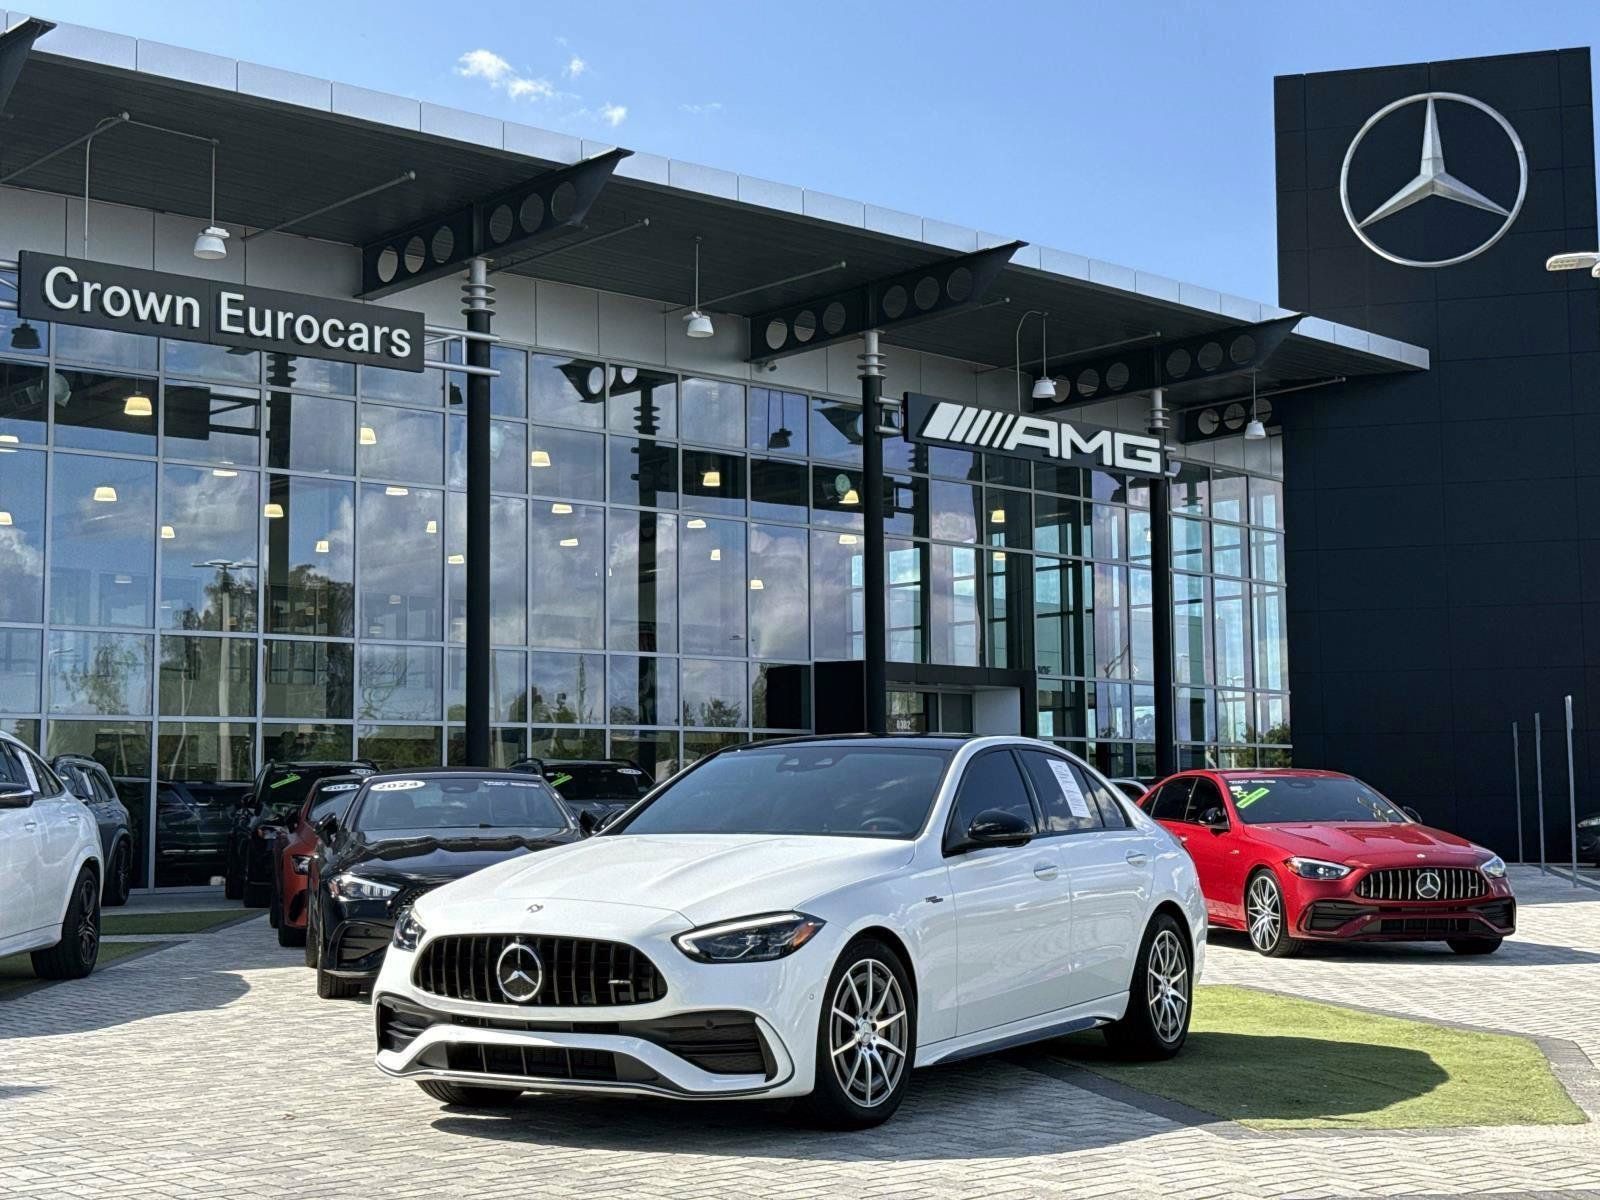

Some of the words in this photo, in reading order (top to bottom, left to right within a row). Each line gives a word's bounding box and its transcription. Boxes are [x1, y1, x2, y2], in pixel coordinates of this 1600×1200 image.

[45, 266, 200, 328] Crown
[220, 291, 412, 358] Eurocars
[1003, 415, 1161, 474] AMG
[377, 781, 419, 790] 2024
